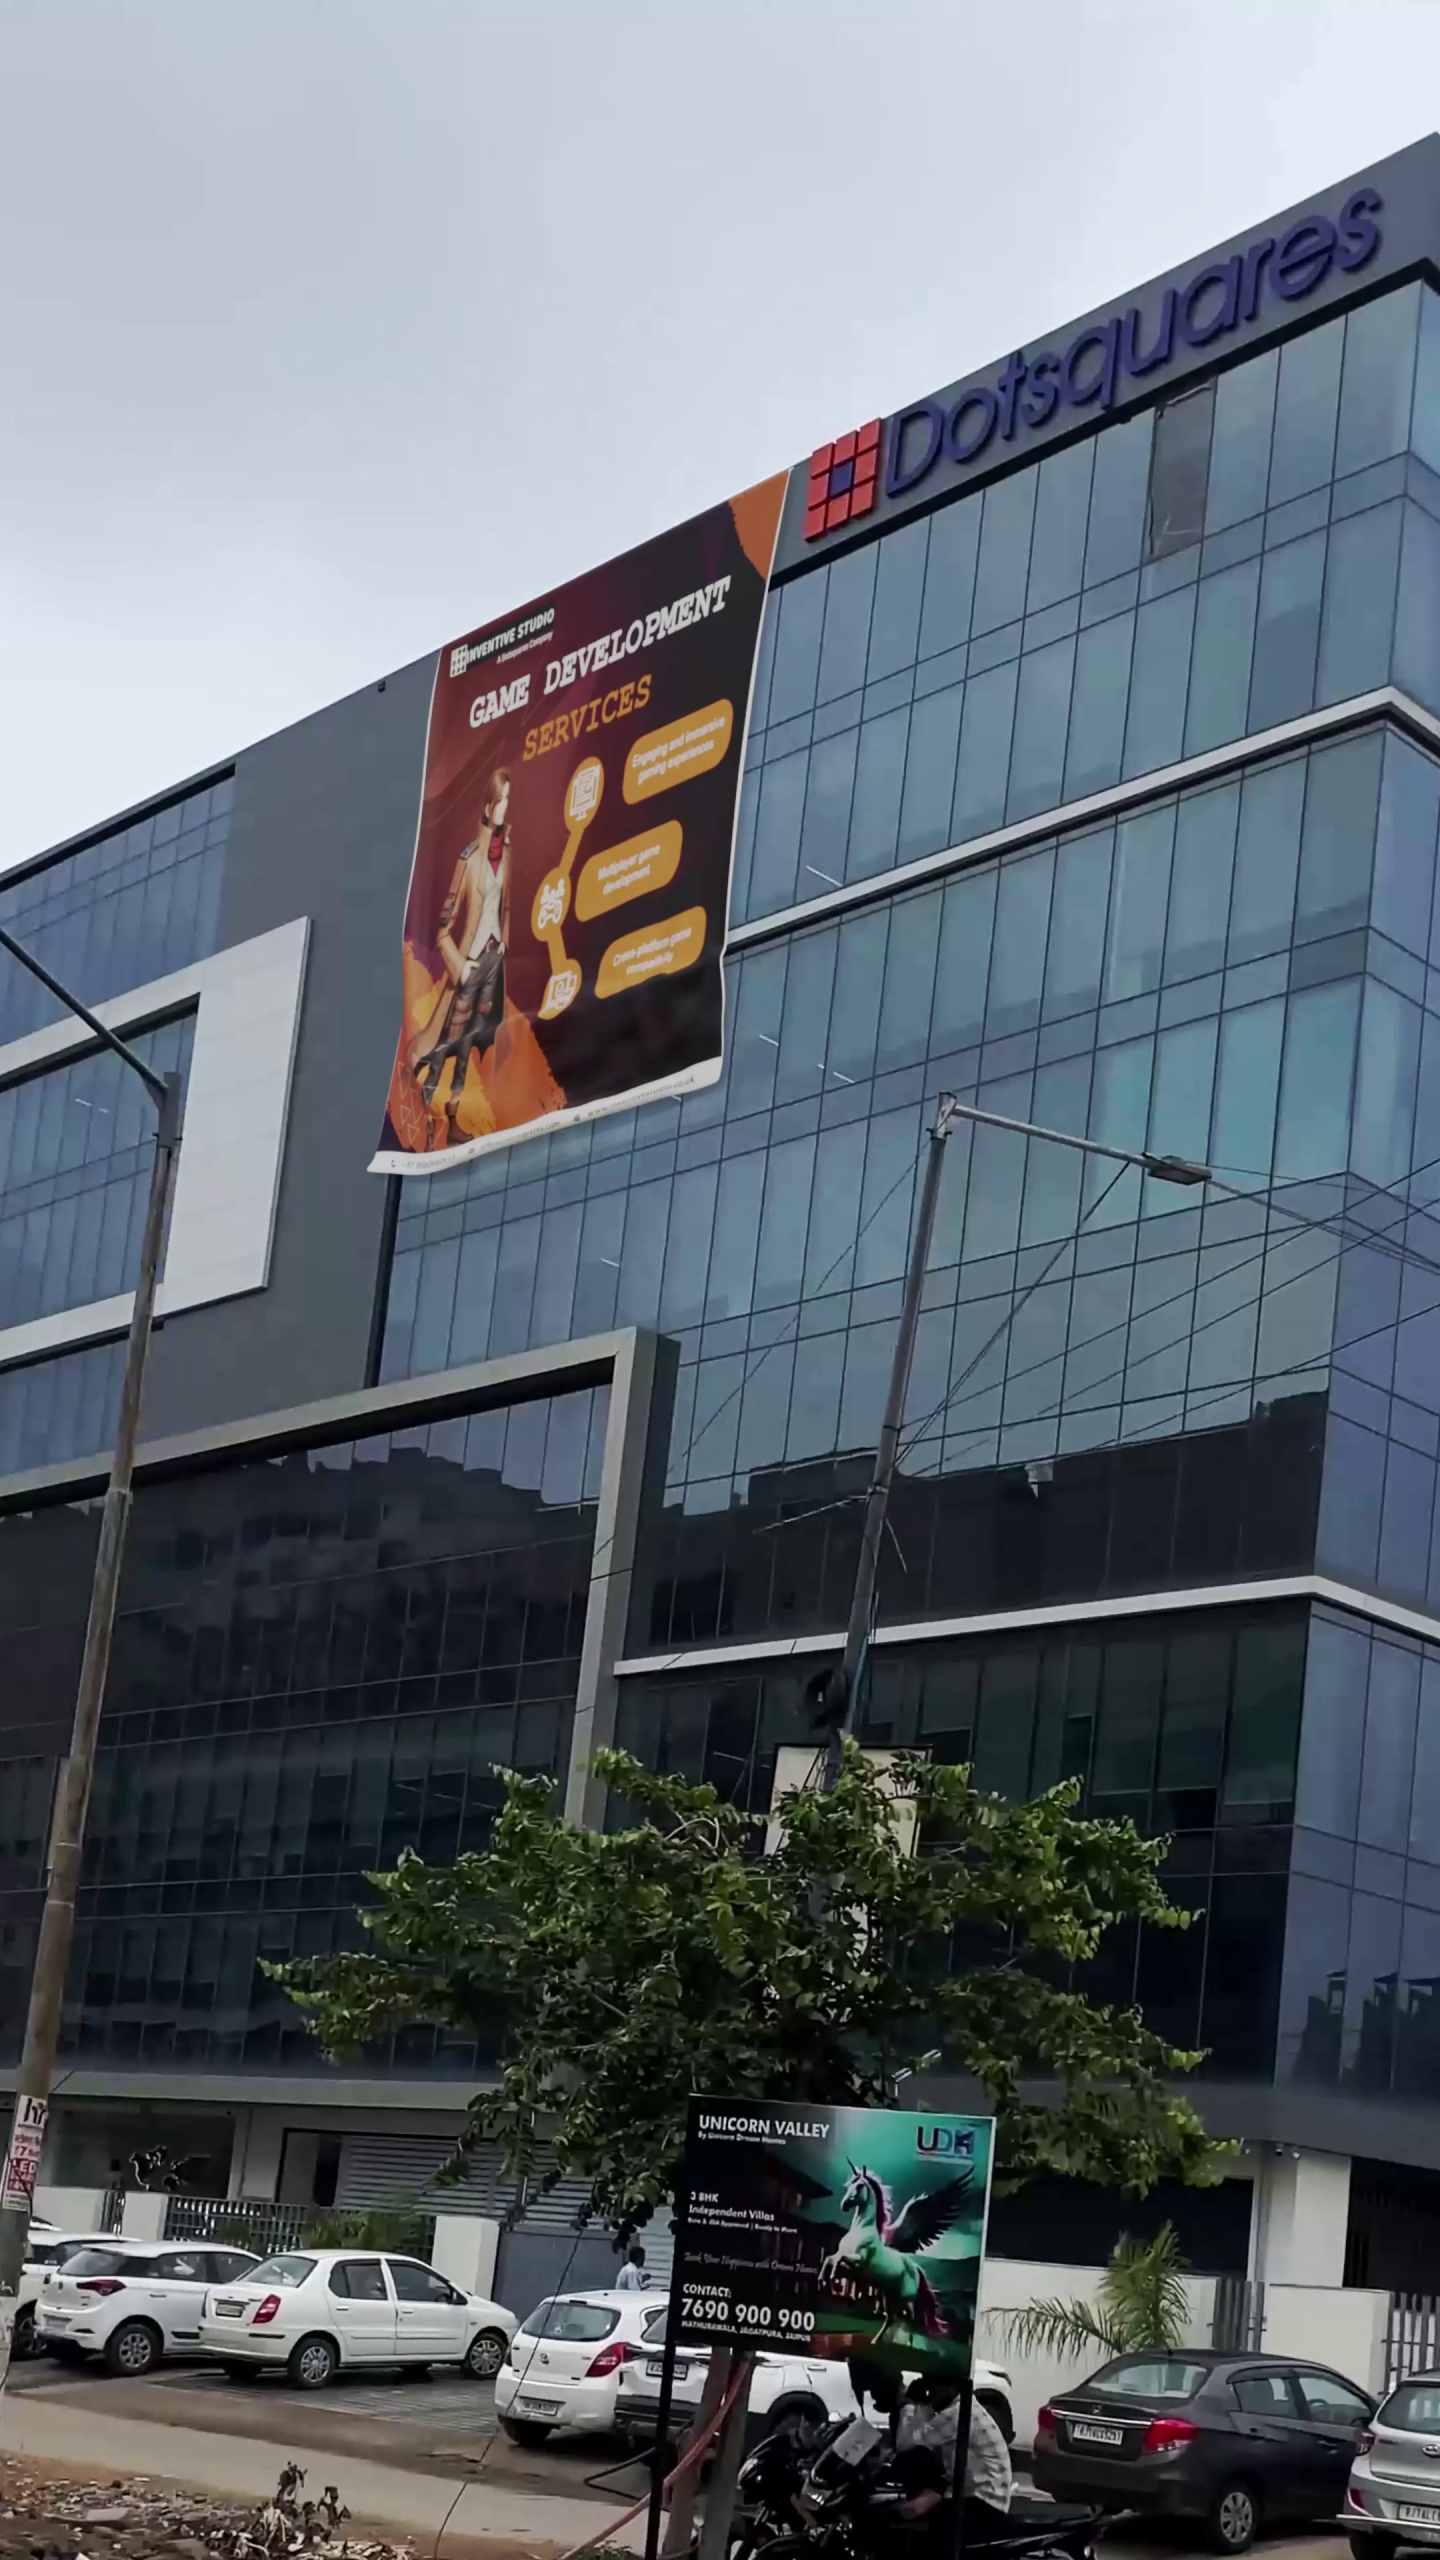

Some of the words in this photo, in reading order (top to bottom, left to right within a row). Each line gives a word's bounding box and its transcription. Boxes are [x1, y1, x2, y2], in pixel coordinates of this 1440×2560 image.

[884, 187, 1384, 498] Dotsquares
[466, 627, 516, 664] INVENTIVE
[517, 608, 555, 639] STUDIO
[469, 674, 531, 728] GAME
[543, 575, 732, 695] DEVELOPMENT
[529, 631, 553, 649] Company
[523, 674, 652, 761] SERVICES
[632, 743, 668, 768] Engaging
[669, 733, 685, 751] and
[685, 716, 726, 743] immersive
[637, 761, 667, 785] gaming
[667, 739, 714, 769] experiences
[598, 854, 638, 881] Multiplayer
[638, 844, 661, 864] game
[603, 863, 651, 895] development
[613, 937, 670, 967] Cross-platform
[670, 927, 692, 947] game
[699, 2114, 770, 2135] UNICORN
[774, 2120, 830, 2138] VALLEY
[689, 2204, 747, 2219] Independent
[749, 2209, 775, 2221] Villas
[690, 2191, 696, 2201] 3
[699, 2192, 719, 2202] BHK
[683, 2283, 731, 2298] CONTACT:
[682, 2298, 728, 2320] 7690
[735, 2303, 771, 2325] 900
[778, 2308, 815, 2331] 900
